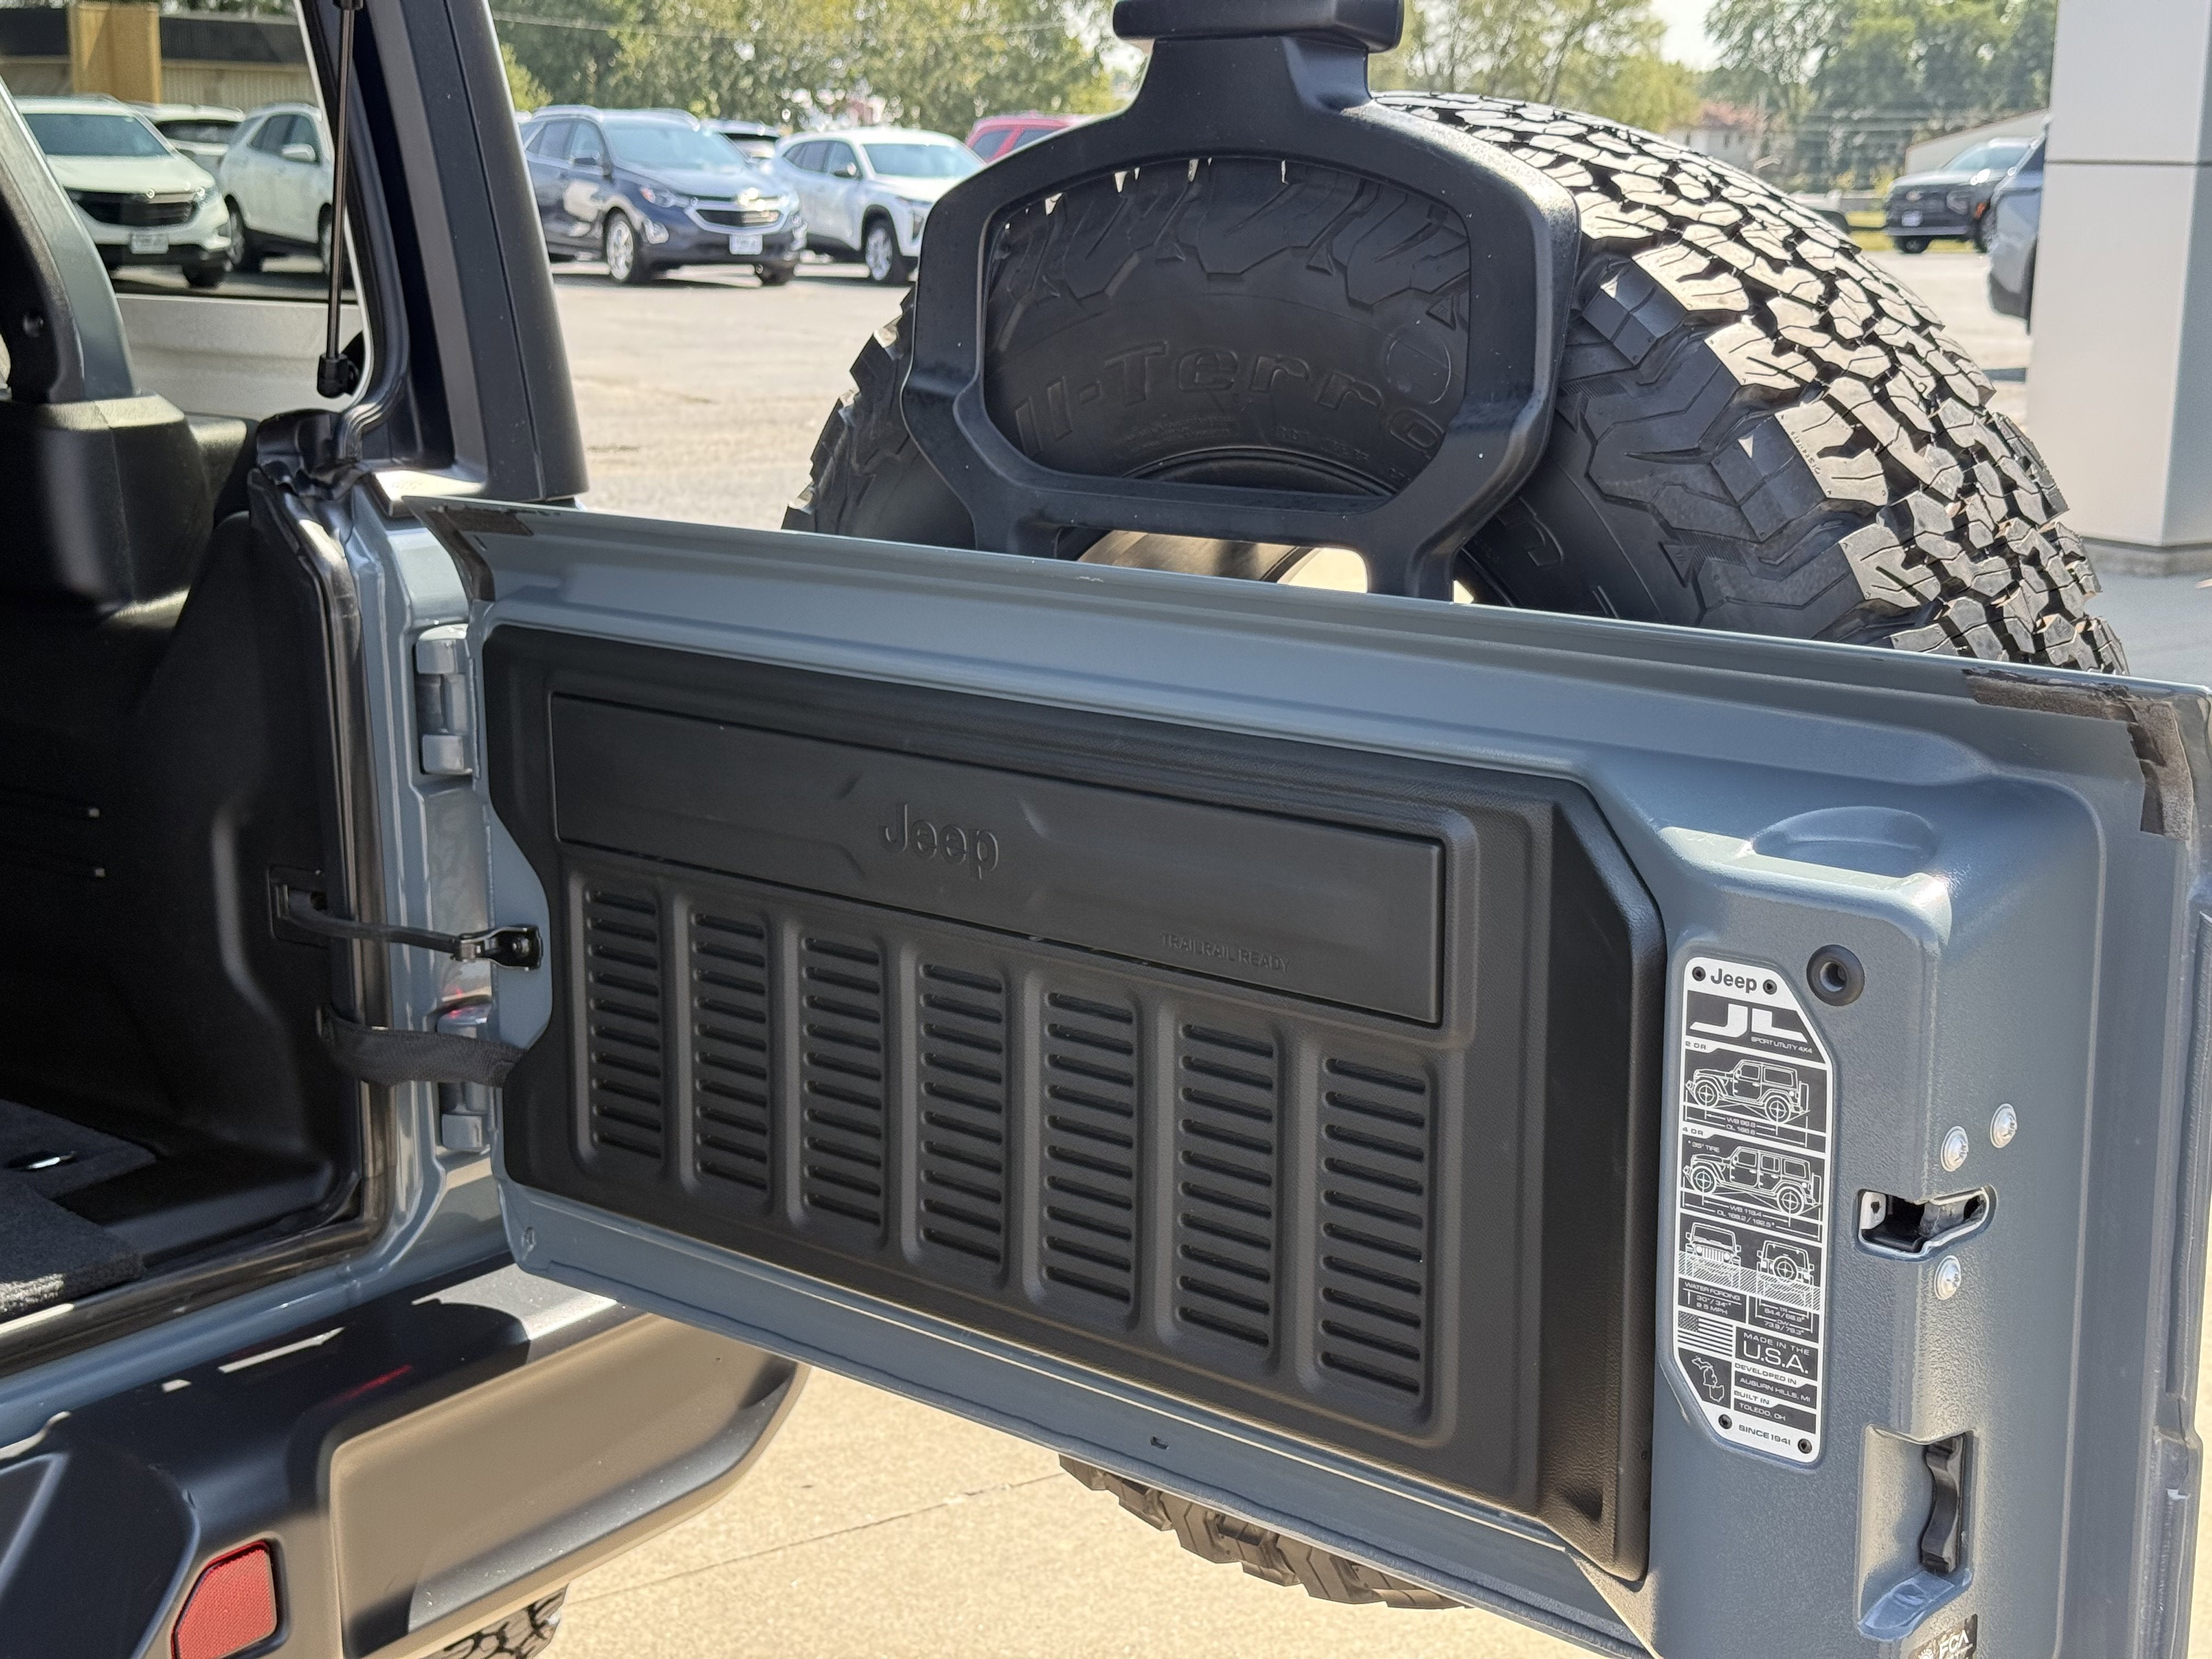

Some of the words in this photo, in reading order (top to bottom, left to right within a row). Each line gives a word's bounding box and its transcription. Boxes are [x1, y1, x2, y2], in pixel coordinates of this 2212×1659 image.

[882, 802, 999, 879] Jeep
[1711, 968, 1757, 994] Jeep
[1689, 1003, 1808, 1043] JL
[1684, 1281, 1709, 1294] WATER
[1710, 1306, 1728, 1315] MPH
[1743, 1332, 1774, 1345] MADE
[1776, 1340, 1787, 1349] IN
[1790, 1342, 1810, 1356] THE
[1743, 1340, 1809, 1374] U.S.A.
[1735, 1363, 1786, 1381] DEVELOPED
[1787, 1375, 1797, 1385] IN
[1734, 1390, 1758, 1401] BUILT
[1760, 1396, 1770, 1405] IN
[1740, 1377, 1774, 1392] AUBURN
[1801, 1393, 1810, 1402] MI
[1774, 1413, 1786, 1421] OH
[1739, 1425, 1769, 1438] SINCE
[1771, 1434, 1791, 1446] 1941
